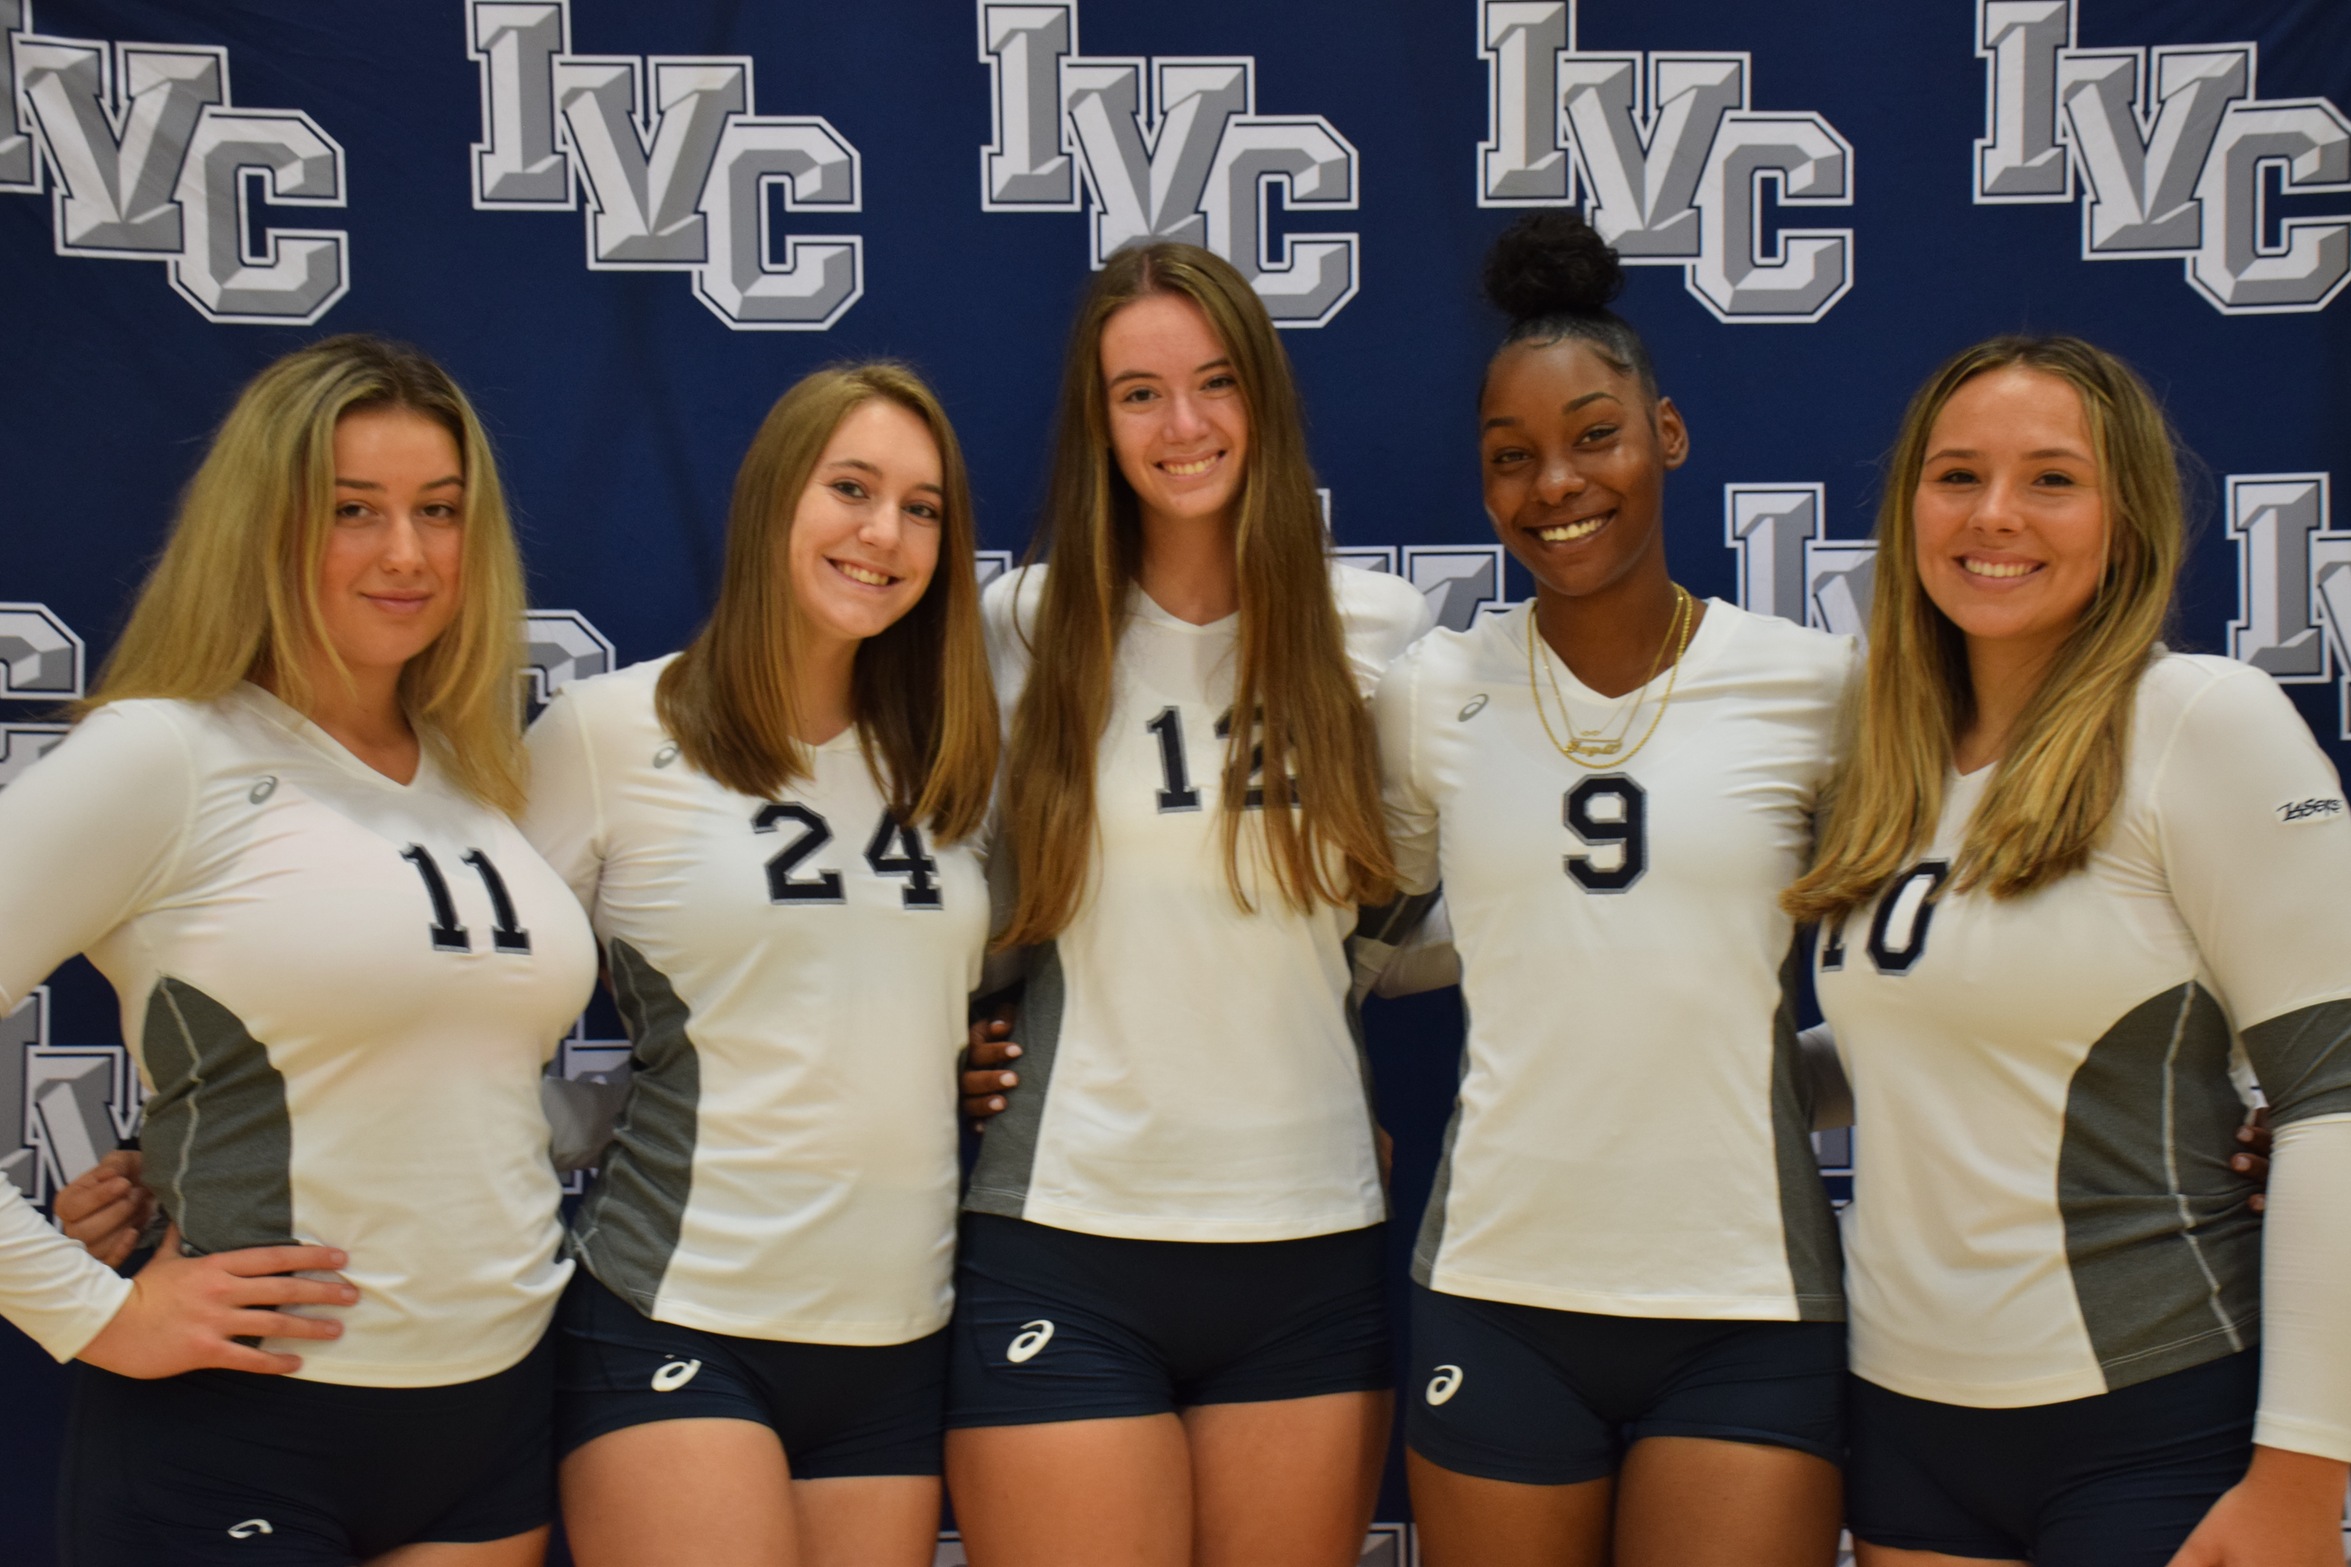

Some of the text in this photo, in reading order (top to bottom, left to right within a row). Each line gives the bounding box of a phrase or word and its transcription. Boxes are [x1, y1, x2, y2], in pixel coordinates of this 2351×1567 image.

[467, 0, 864, 330] IVC
[977, 0, 1358, 328] IVC
[1476, 0, 1854, 323] IVC
[1973, 0, 2351, 315] IVC
[399, 842, 531, 955] 11
[751, 801, 943, 911] 24
[1562, 772, 1648, 894] 9
